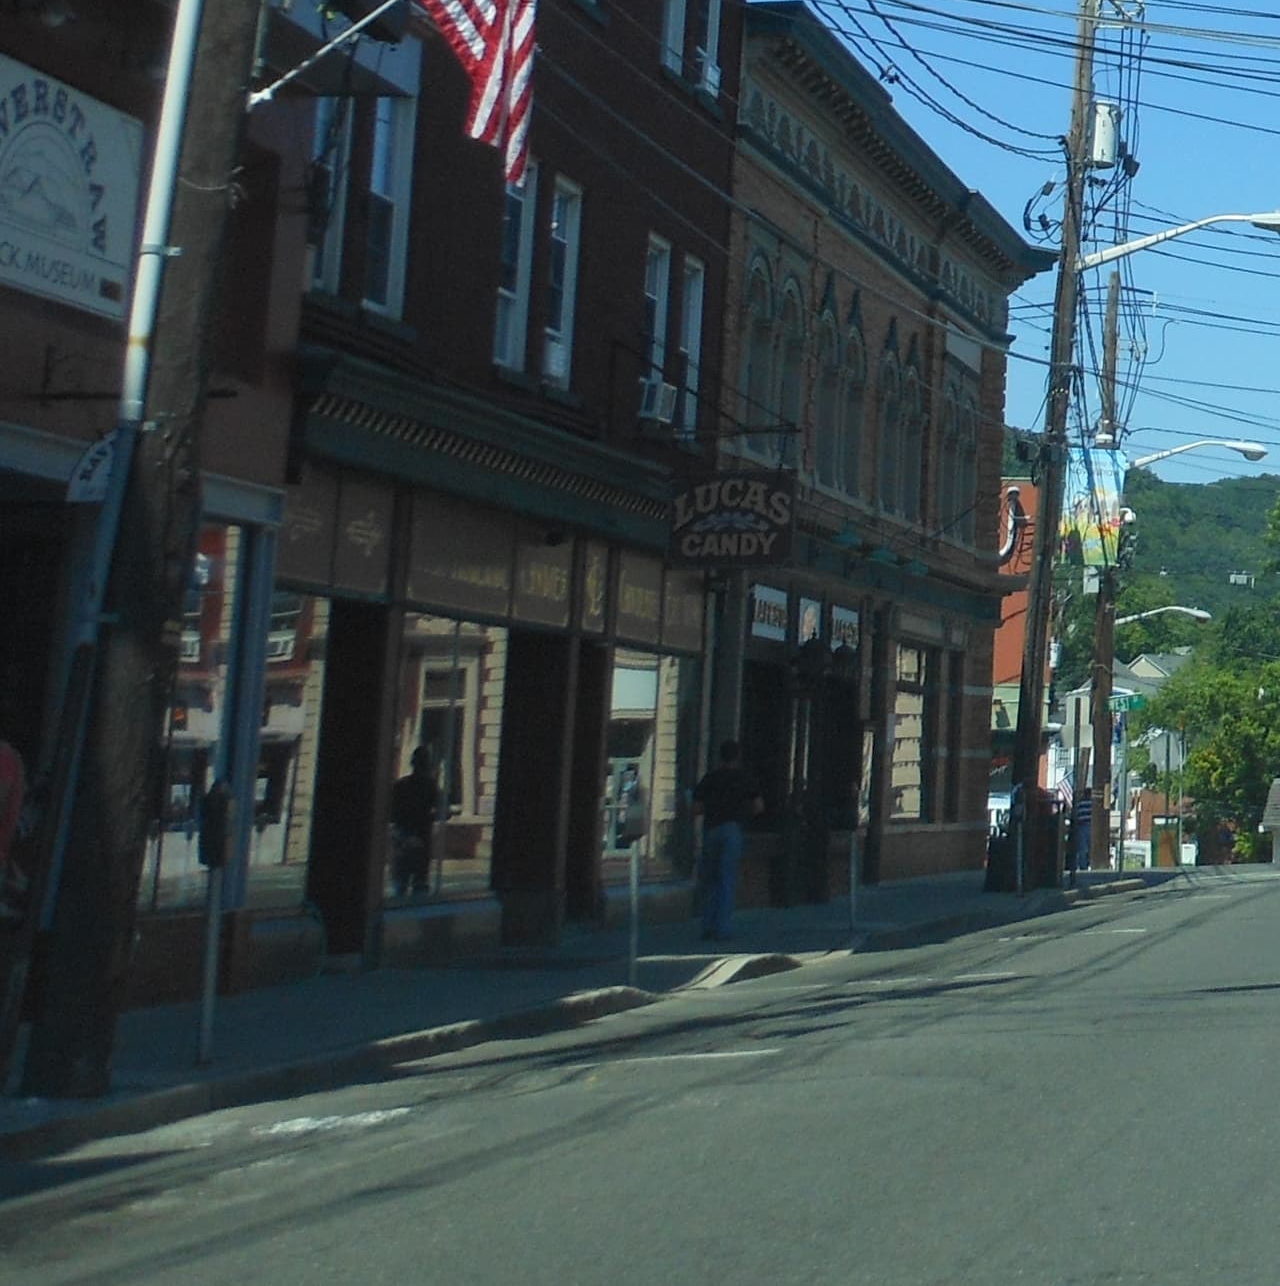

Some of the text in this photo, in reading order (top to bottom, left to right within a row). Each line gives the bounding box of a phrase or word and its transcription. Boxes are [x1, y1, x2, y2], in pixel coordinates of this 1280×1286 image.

[24, 250, 96, 290] MUSEUM
[672, 479, 791, 532] LUCAS
[681, 532, 778, 556] CANDY
